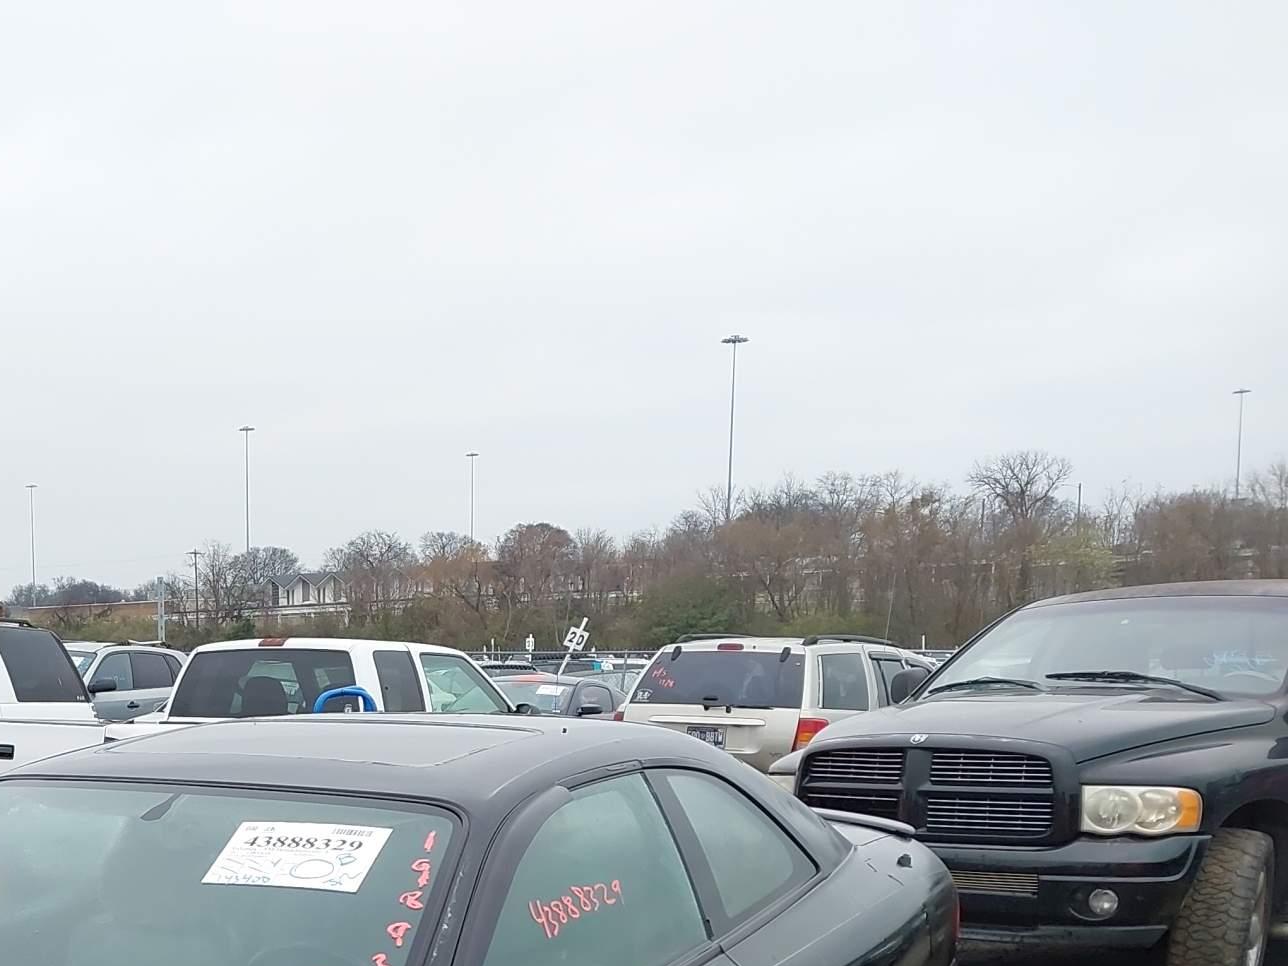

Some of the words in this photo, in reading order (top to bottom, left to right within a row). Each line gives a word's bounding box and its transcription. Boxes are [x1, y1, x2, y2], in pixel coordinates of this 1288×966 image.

[567, 631, 585, 646] 20
[244, 835, 364, 851] 43888329
[528, 880, 624, 938] 43888329
